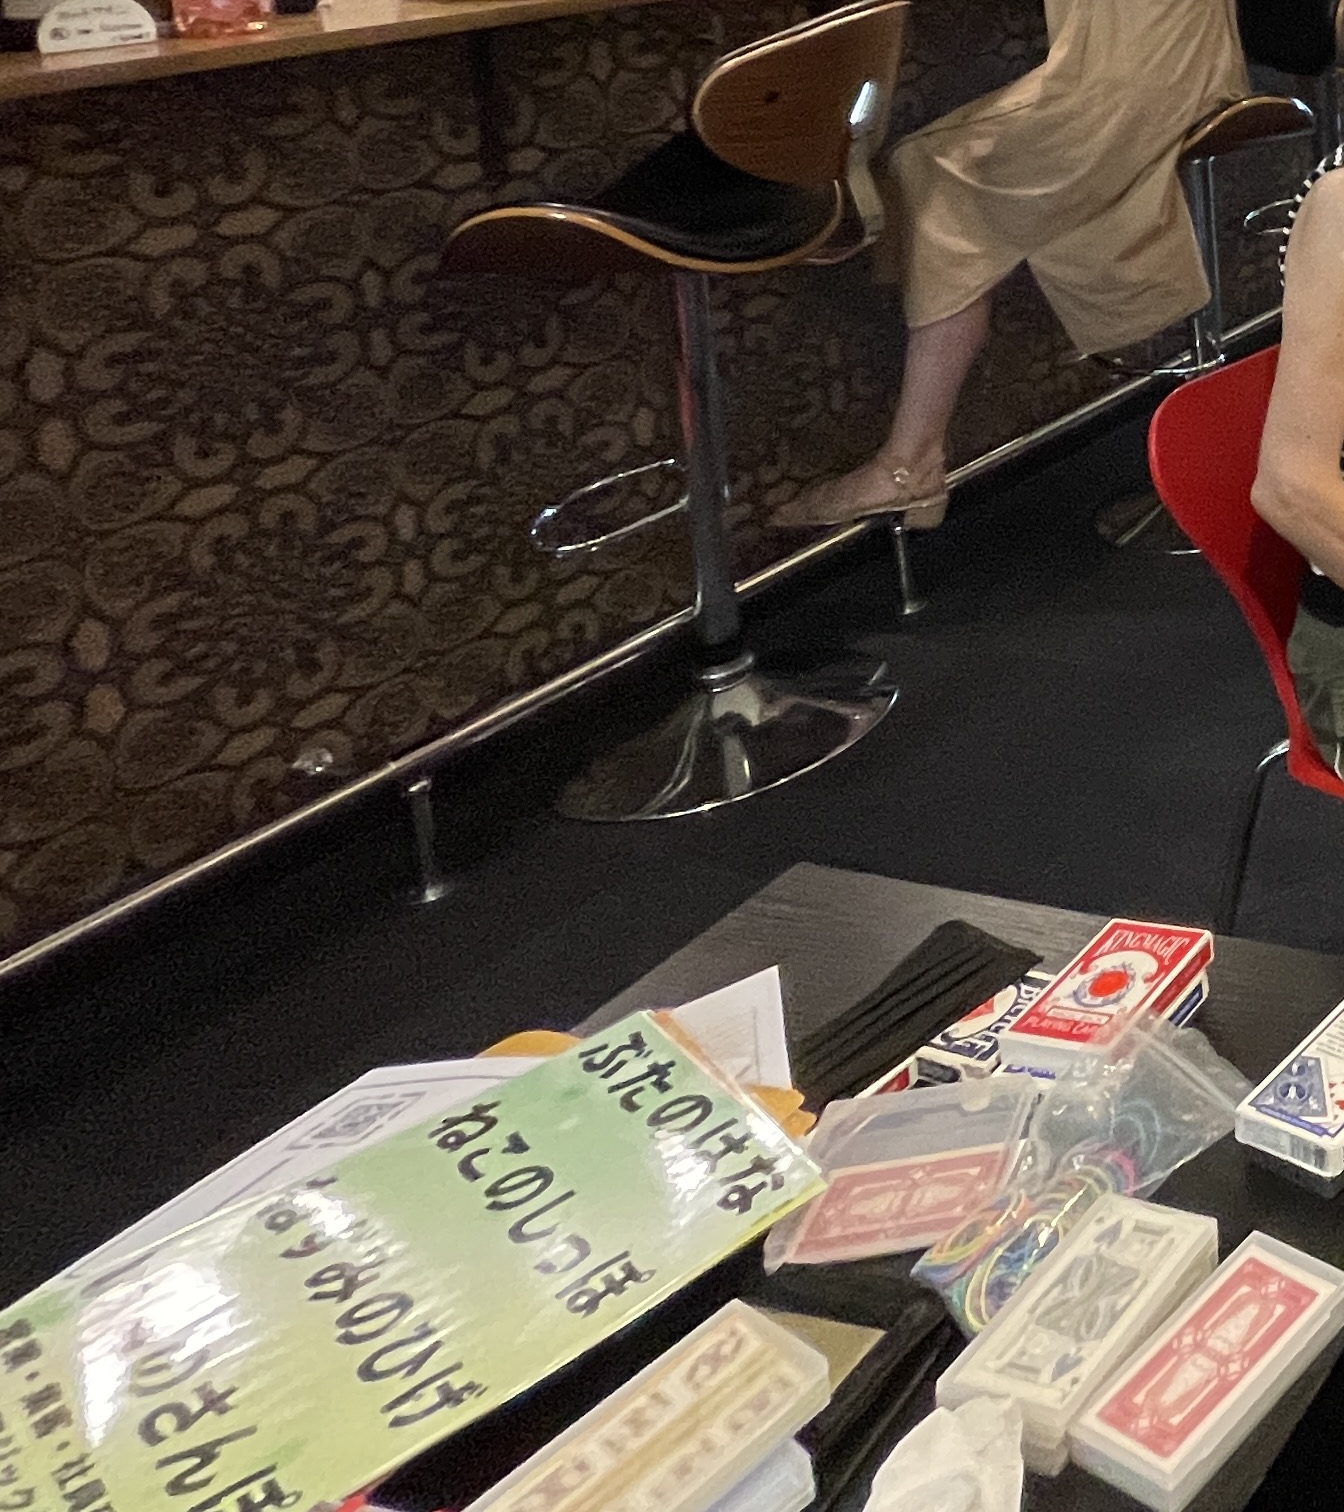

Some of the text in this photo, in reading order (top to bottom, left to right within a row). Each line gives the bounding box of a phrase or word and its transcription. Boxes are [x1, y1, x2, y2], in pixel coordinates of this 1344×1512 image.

[427, 1100, 657, 1318] ねこのしっぽ
